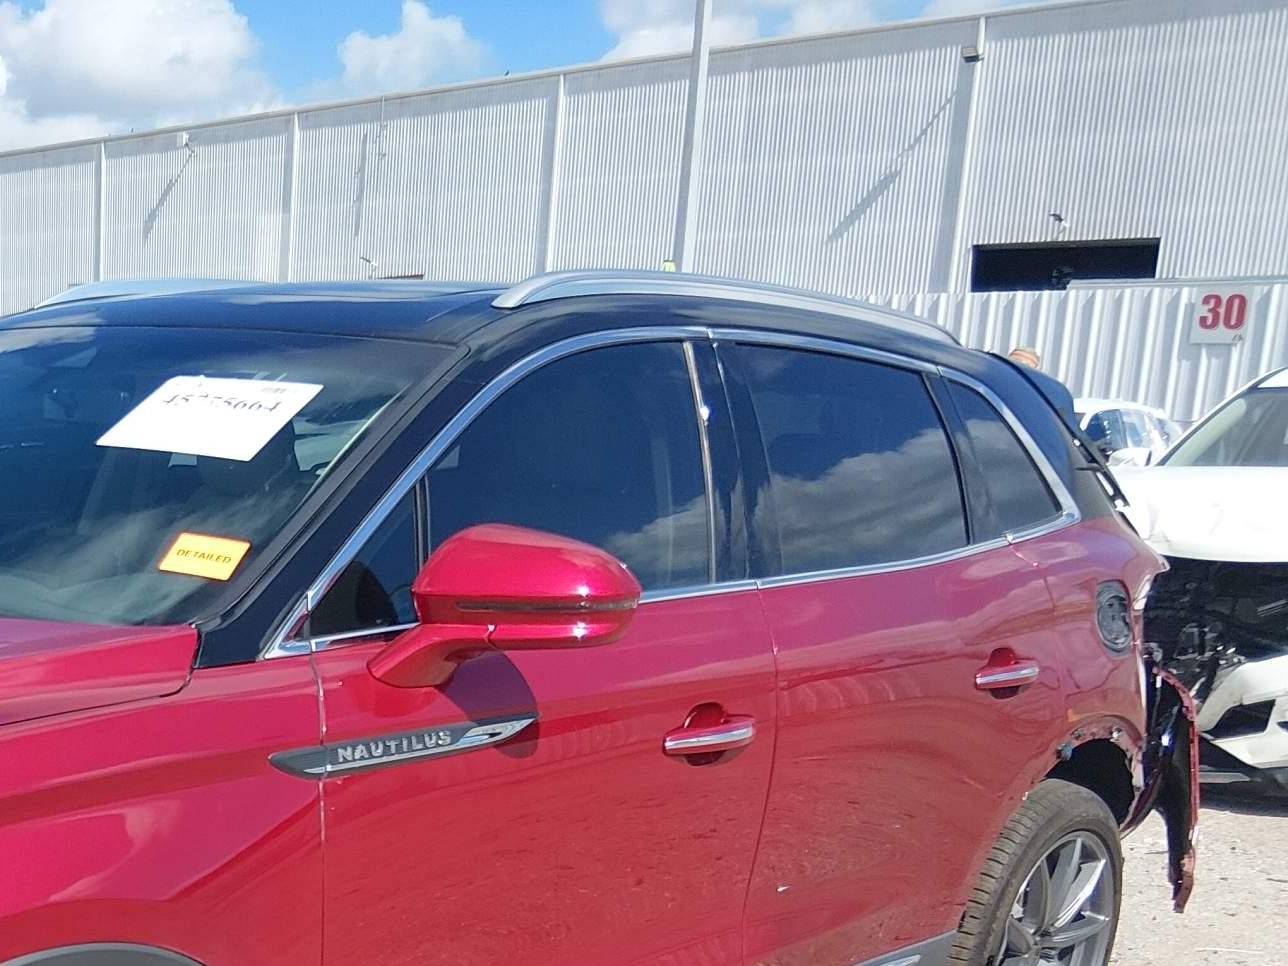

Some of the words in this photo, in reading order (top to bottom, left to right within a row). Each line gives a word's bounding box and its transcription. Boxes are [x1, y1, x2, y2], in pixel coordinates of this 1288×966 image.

[1198, 293, 1247, 330] 30
[175, 548, 232, 564] DETAILED
[337, 730, 452, 763] NAUTILUS
